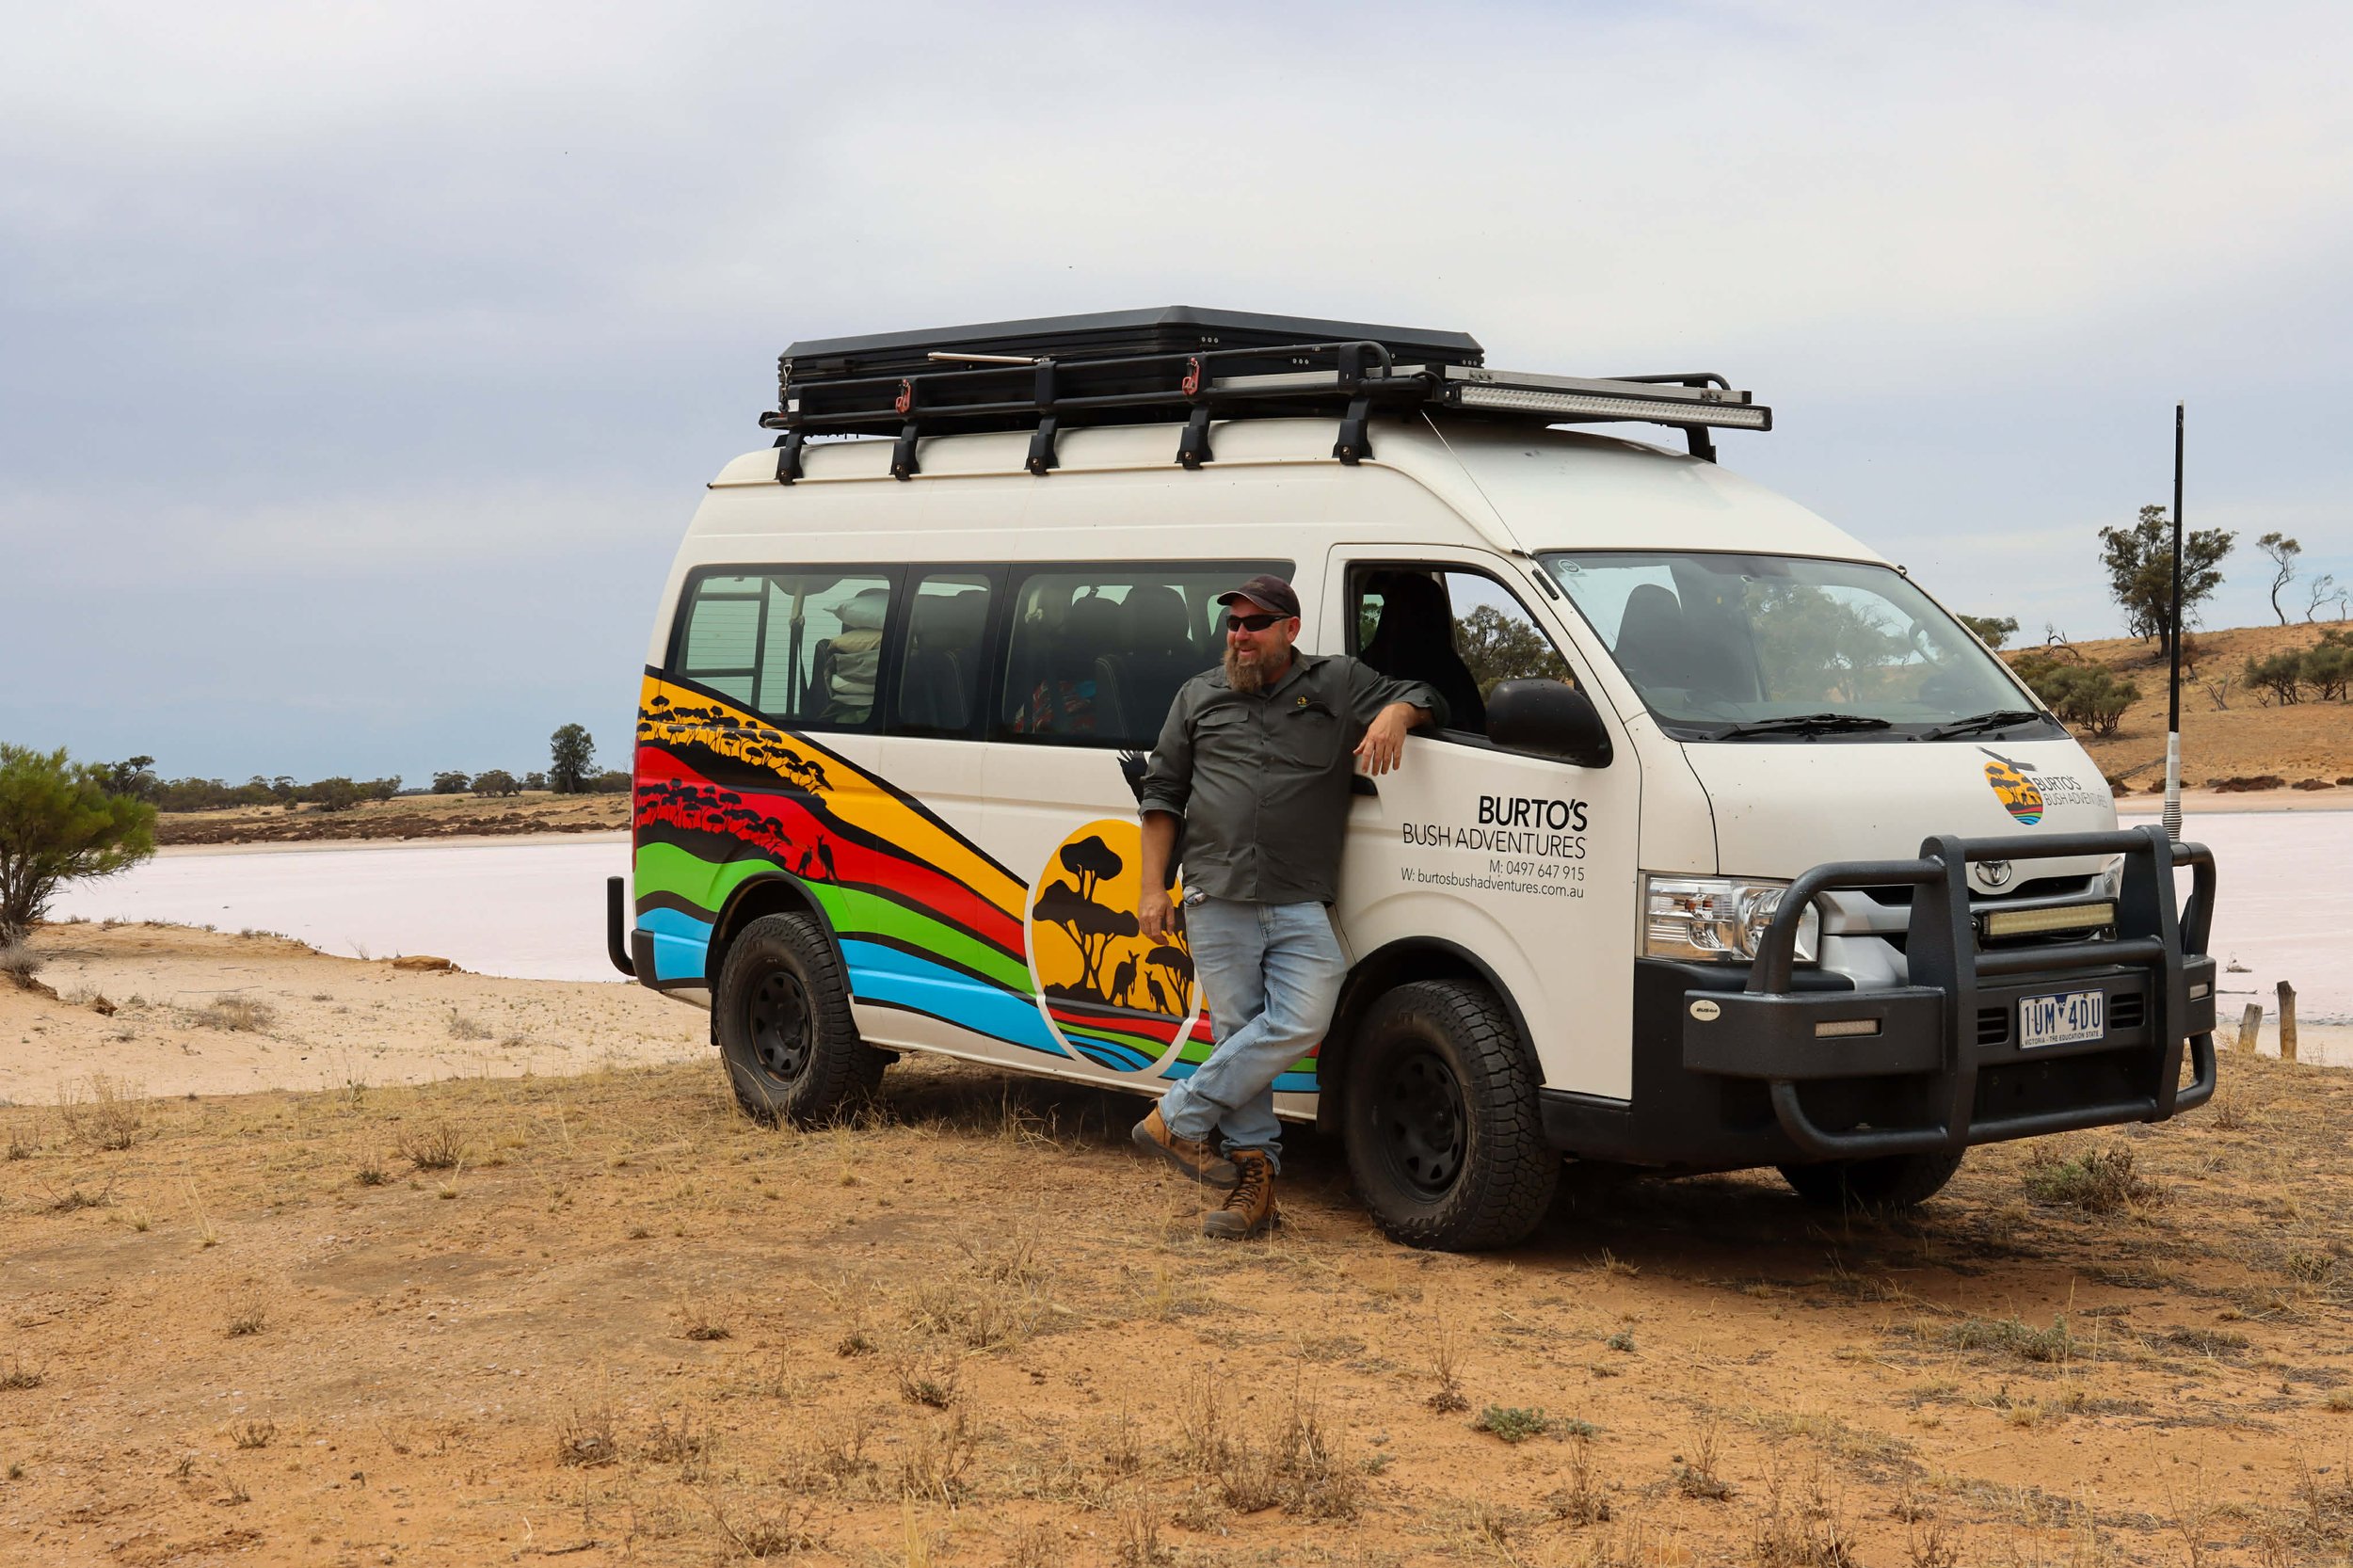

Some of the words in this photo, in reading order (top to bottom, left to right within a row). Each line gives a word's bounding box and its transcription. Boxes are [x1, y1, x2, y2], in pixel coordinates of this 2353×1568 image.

[2032, 775, 2081, 792] BURTO'S
[2043, 792, 2068, 807] BUSH
[1478, 795, 1589, 832] BURTO'S
[1402, 823, 1450, 848] BUSH
[1455, 827, 1587, 859] ADVENTURES
[1401, 867, 1415, 881] W:
[1417, 870, 1584, 899] burtosbushadventures.com.au
[1489, 859, 1503, 874] M:
[1506, 861, 1535, 876] 0497
[1537, 864, 1560, 879] 647
[1562, 866, 1585, 881] 915
[2025, 1002, 2055, 1036] 1UM
[2069, 998, 2101, 1031] 4DU
[2025, 1037, 2045, 1046] VICTORIA
[2059, 1032, 2085, 1042] EDUCATION
[2086, 1030, 2099, 1038] STATE
